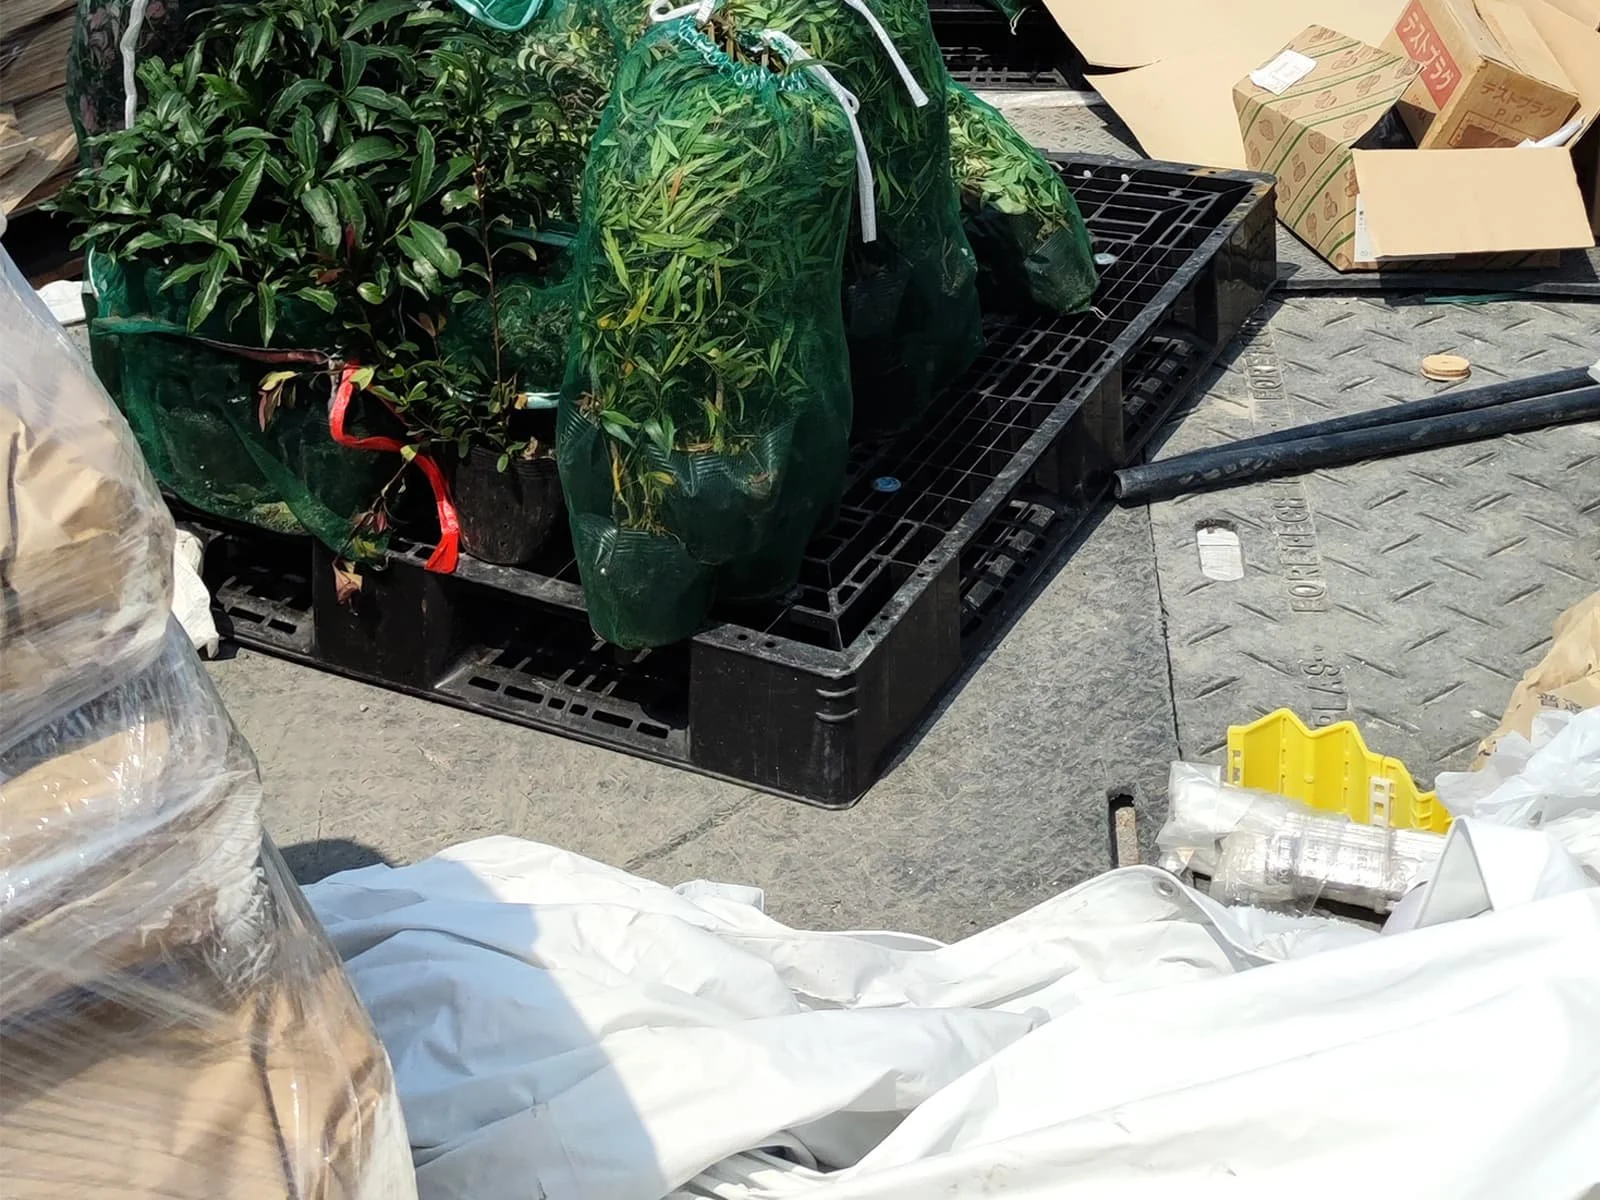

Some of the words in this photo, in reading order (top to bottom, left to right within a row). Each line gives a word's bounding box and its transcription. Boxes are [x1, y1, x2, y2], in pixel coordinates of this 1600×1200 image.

[1402, 11, 1455, 90] テストプラグ
